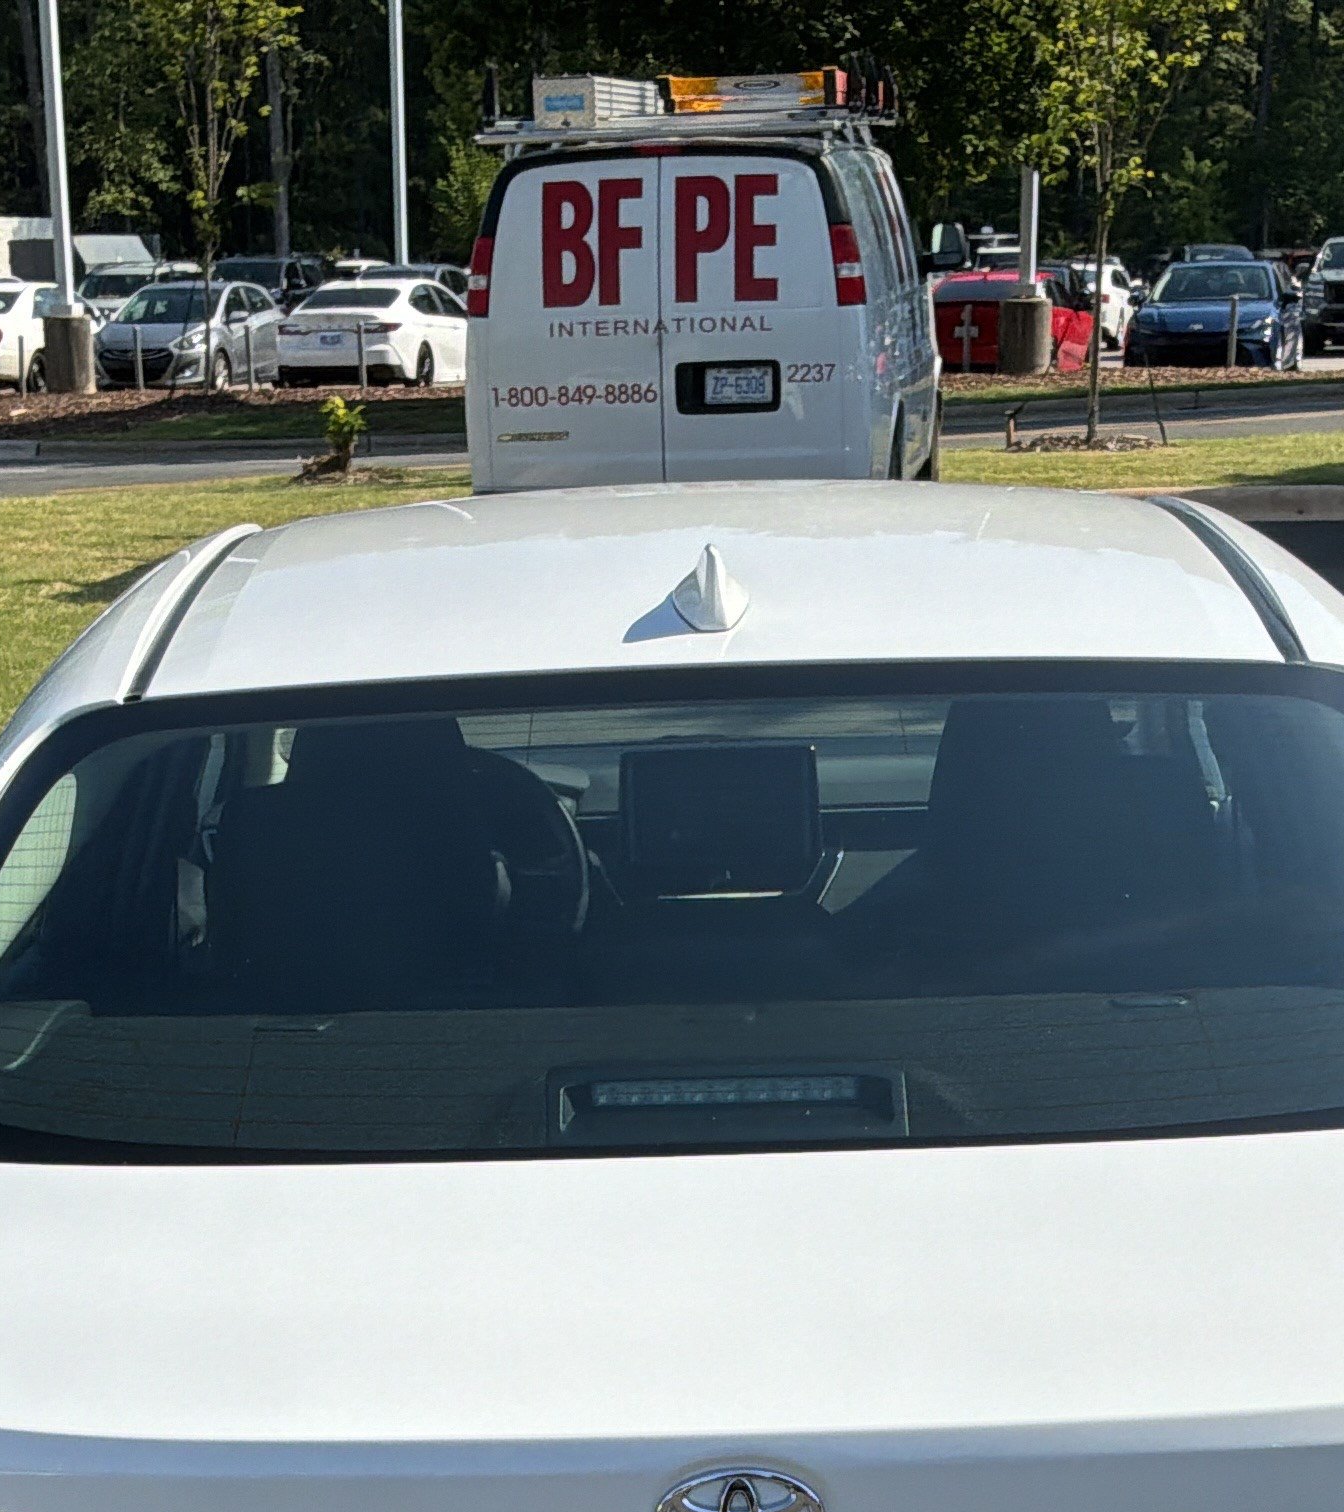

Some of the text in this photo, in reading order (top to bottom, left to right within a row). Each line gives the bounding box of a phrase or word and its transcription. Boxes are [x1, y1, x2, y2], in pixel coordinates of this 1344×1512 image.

[549, 315, 773, 338] INTERNATIONAL
[787, 363, 836, 383] 2237
[492, 383, 657, 408] 1-800-849-8886
